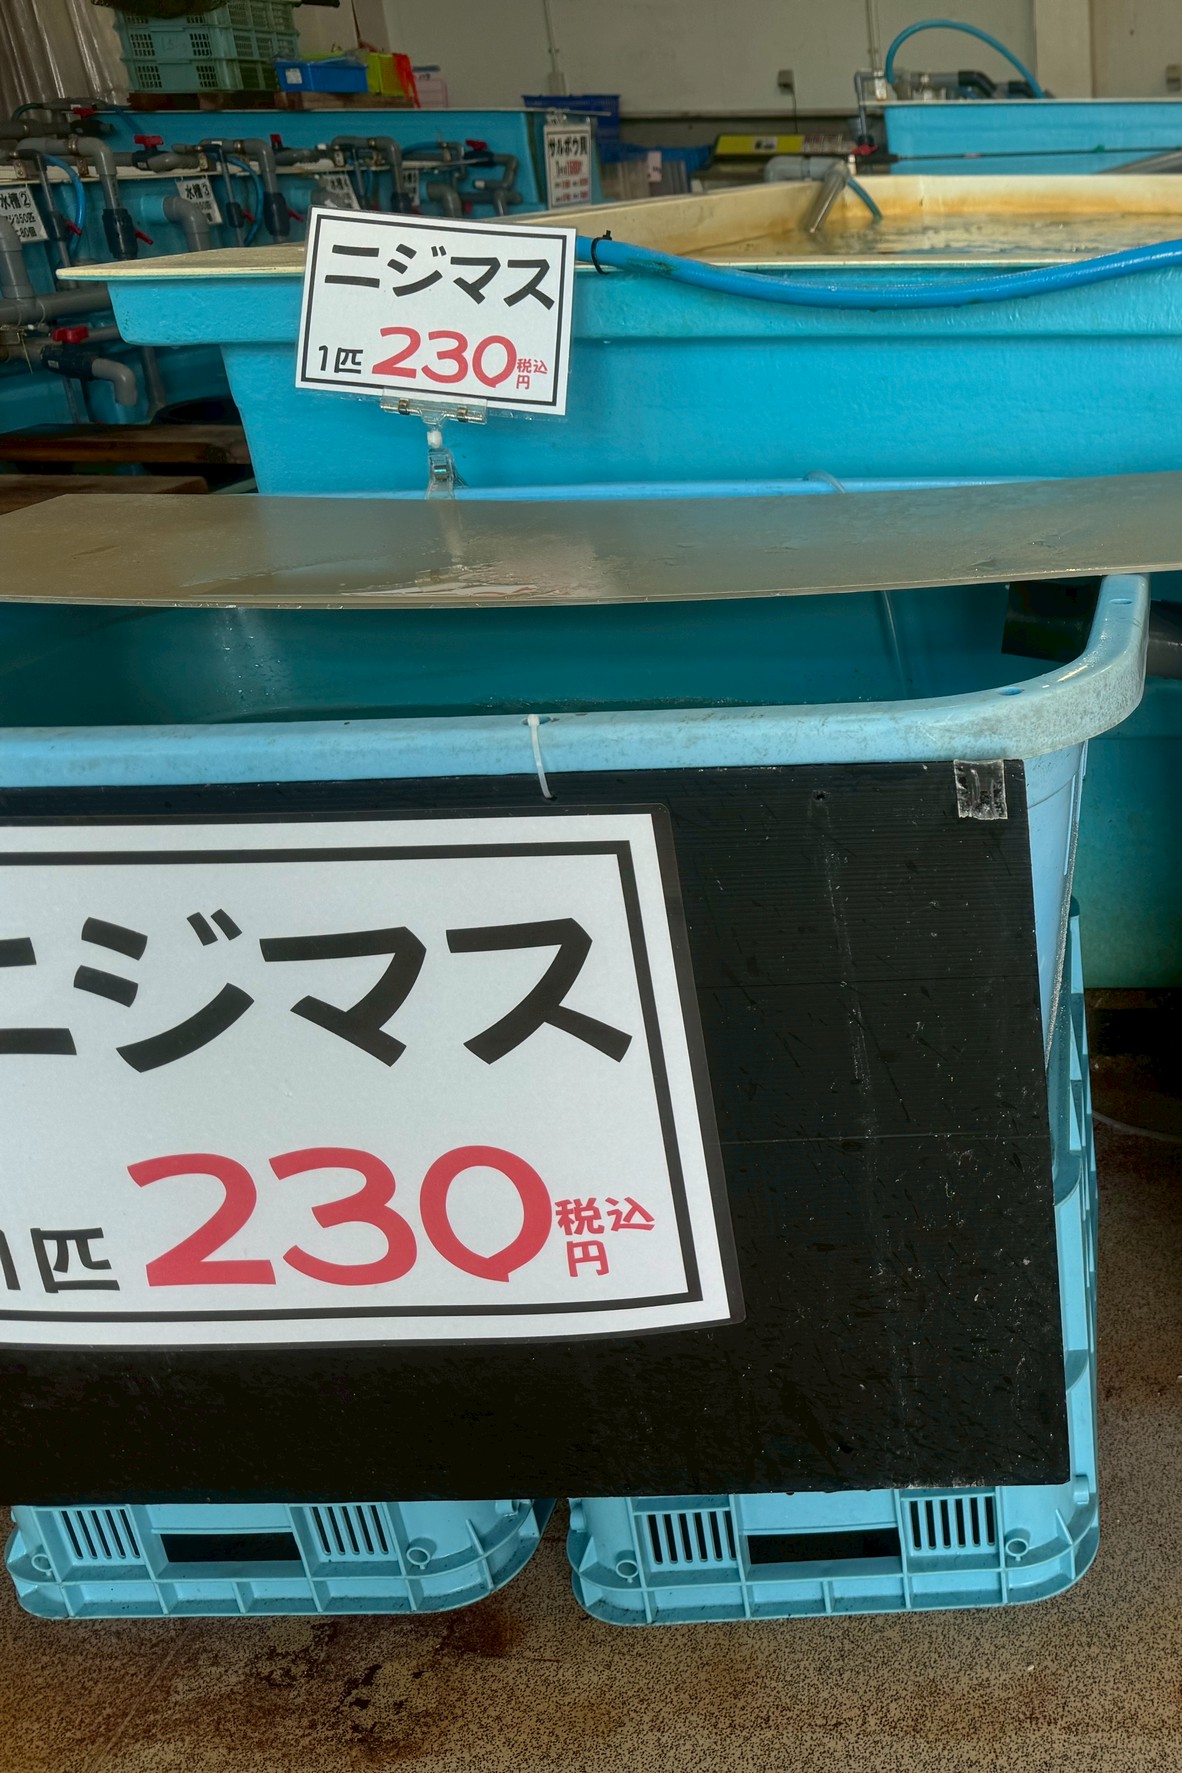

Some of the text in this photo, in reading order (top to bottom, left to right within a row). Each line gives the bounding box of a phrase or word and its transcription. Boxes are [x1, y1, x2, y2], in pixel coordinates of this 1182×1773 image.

[325, 243, 555, 310] ニジマス
[319, 345, 363, 374] 1匹
[371, 327, 517, 388] 230
[0, 1227, 120, 1294] 1匹
[127, 1146, 553, 1287] 230
